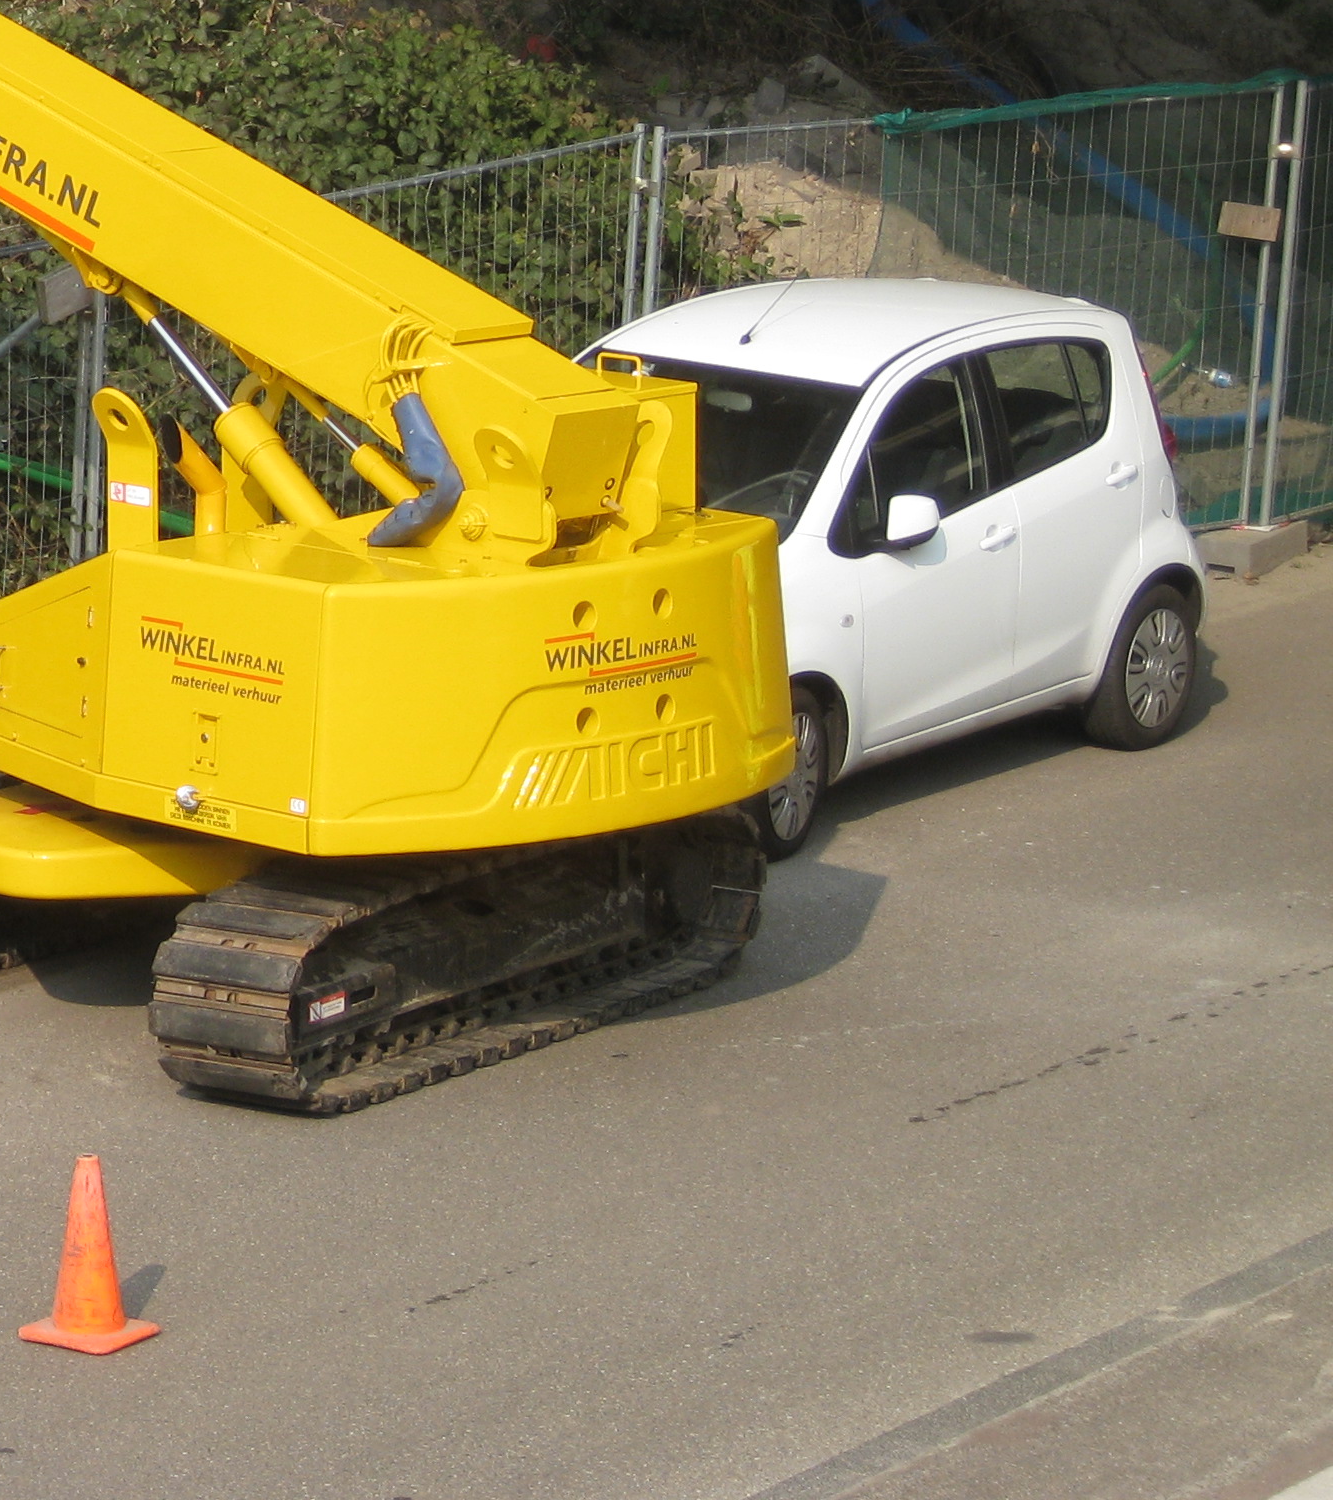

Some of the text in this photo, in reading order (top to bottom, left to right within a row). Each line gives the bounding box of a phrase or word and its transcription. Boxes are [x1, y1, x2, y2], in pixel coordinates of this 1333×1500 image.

[171, 674, 282, 705] materieel verhuur
[584, 665, 694, 695] materieel verhuur
[513, 722, 716, 809] AICHI
